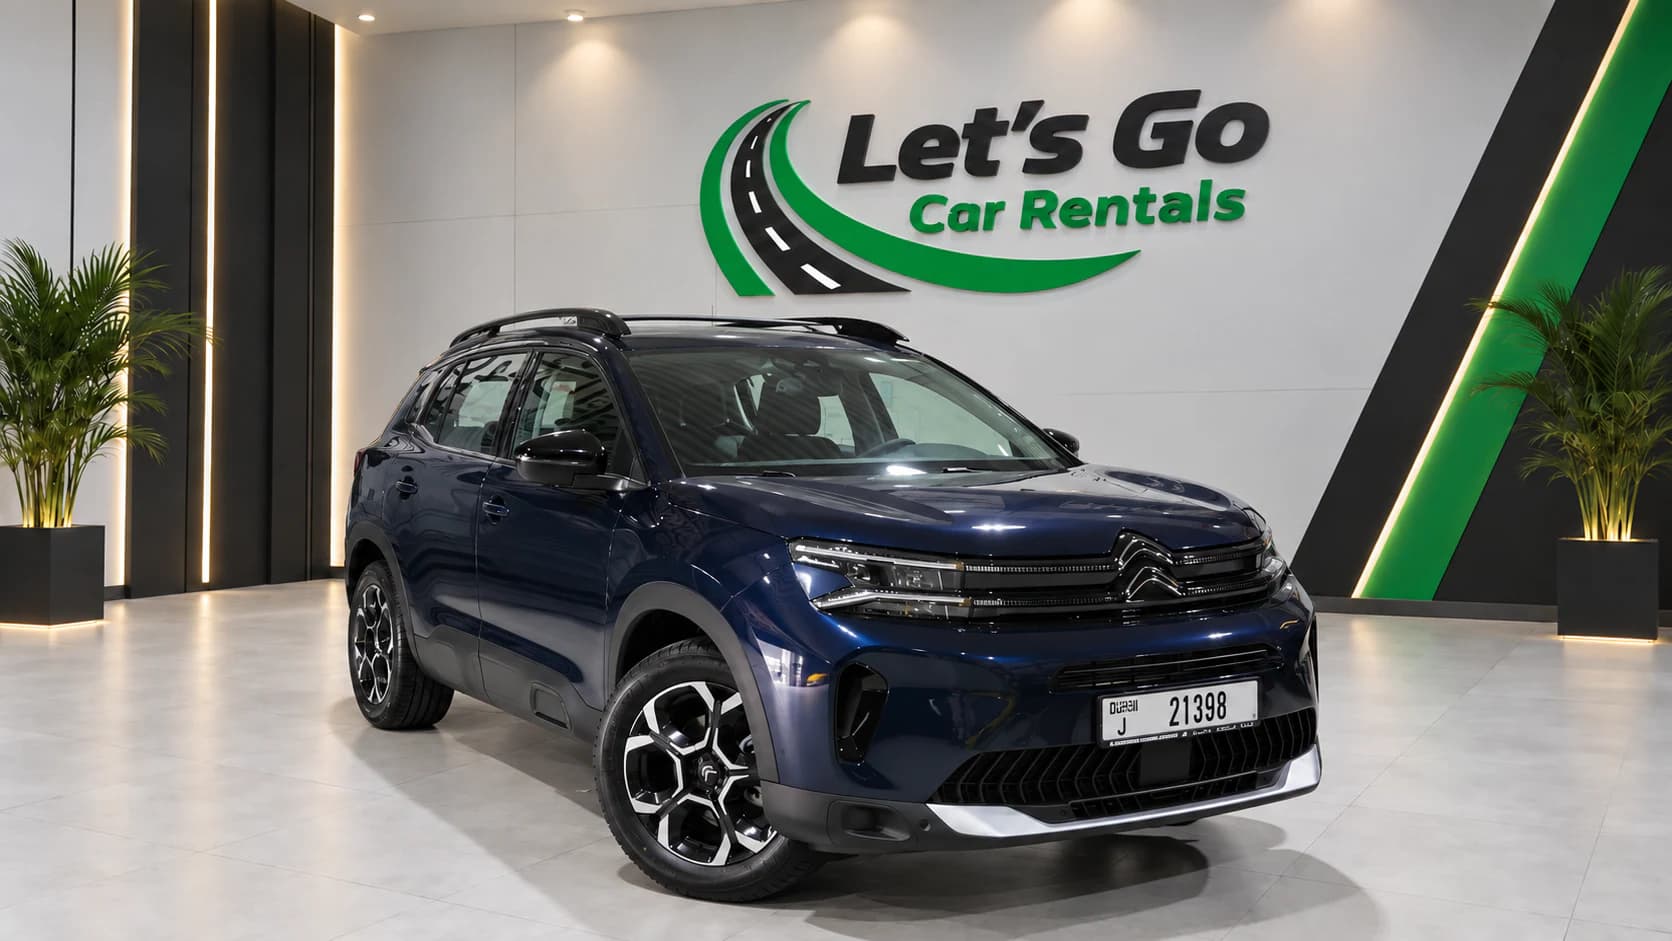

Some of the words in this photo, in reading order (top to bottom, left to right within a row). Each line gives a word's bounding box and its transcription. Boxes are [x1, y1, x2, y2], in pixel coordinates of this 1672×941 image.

[837, 99, 1090, 185] Let's
[1112, 89, 1270, 169] Go
[909, 193, 1005, 234] Car
[1019, 178, 1246, 230] Rentals
[1117, 717, 1126, 736] J
[1169, 691, 1227, 727] 21398
